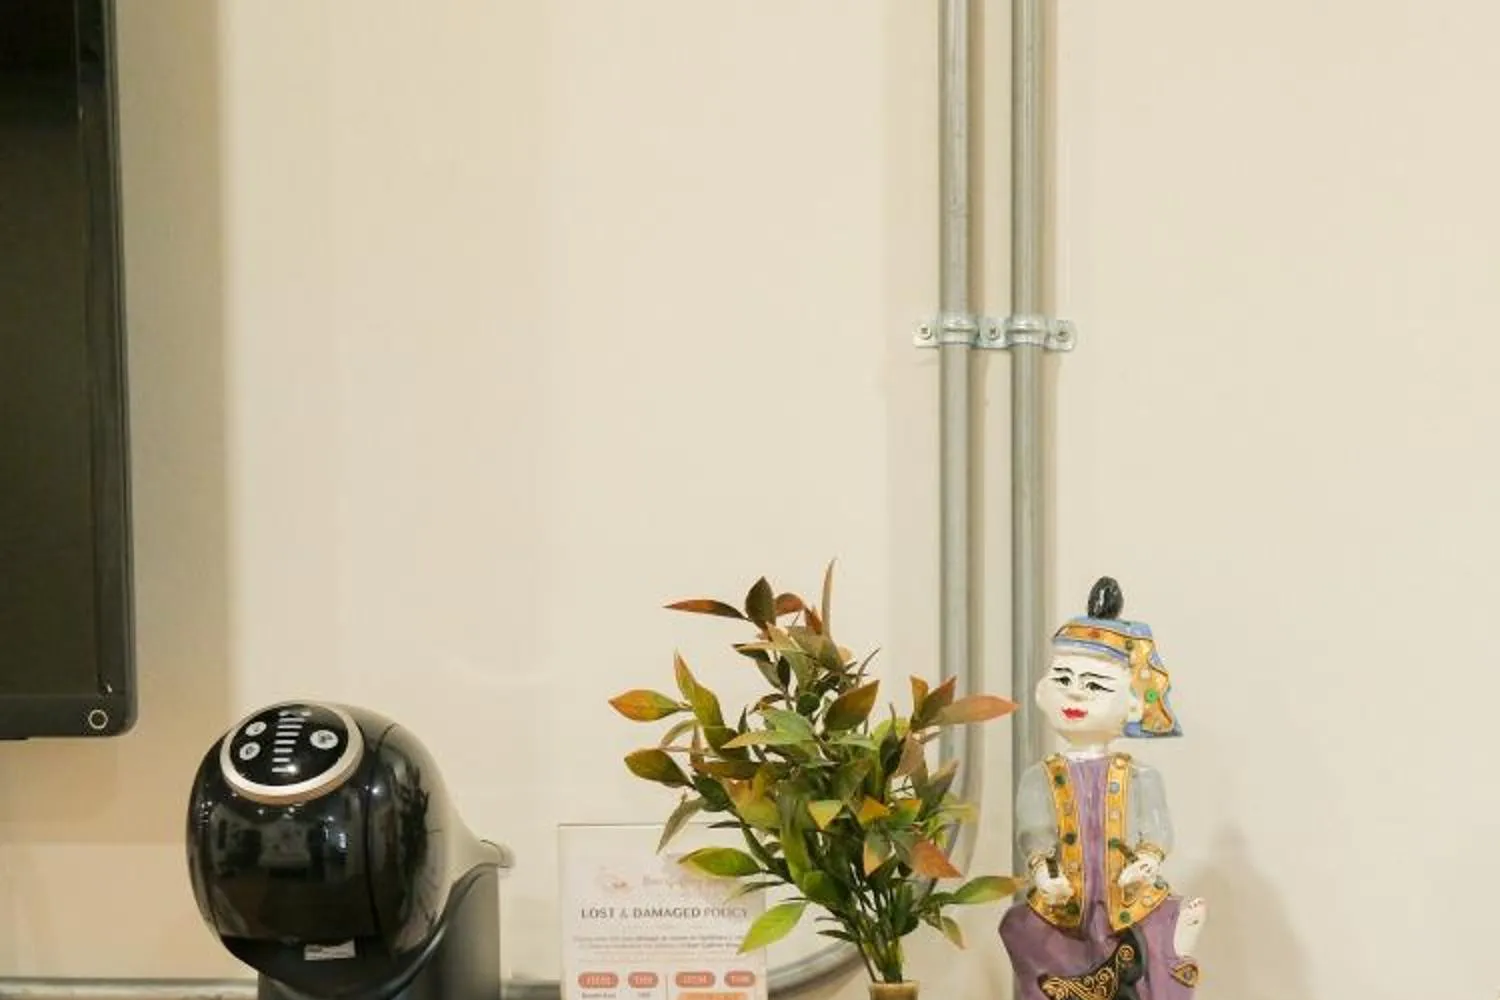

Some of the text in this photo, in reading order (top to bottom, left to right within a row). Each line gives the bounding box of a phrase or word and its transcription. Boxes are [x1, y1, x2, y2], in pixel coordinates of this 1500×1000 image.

[581, 906, 748, 919] LOST & DAMAGED POLICY
